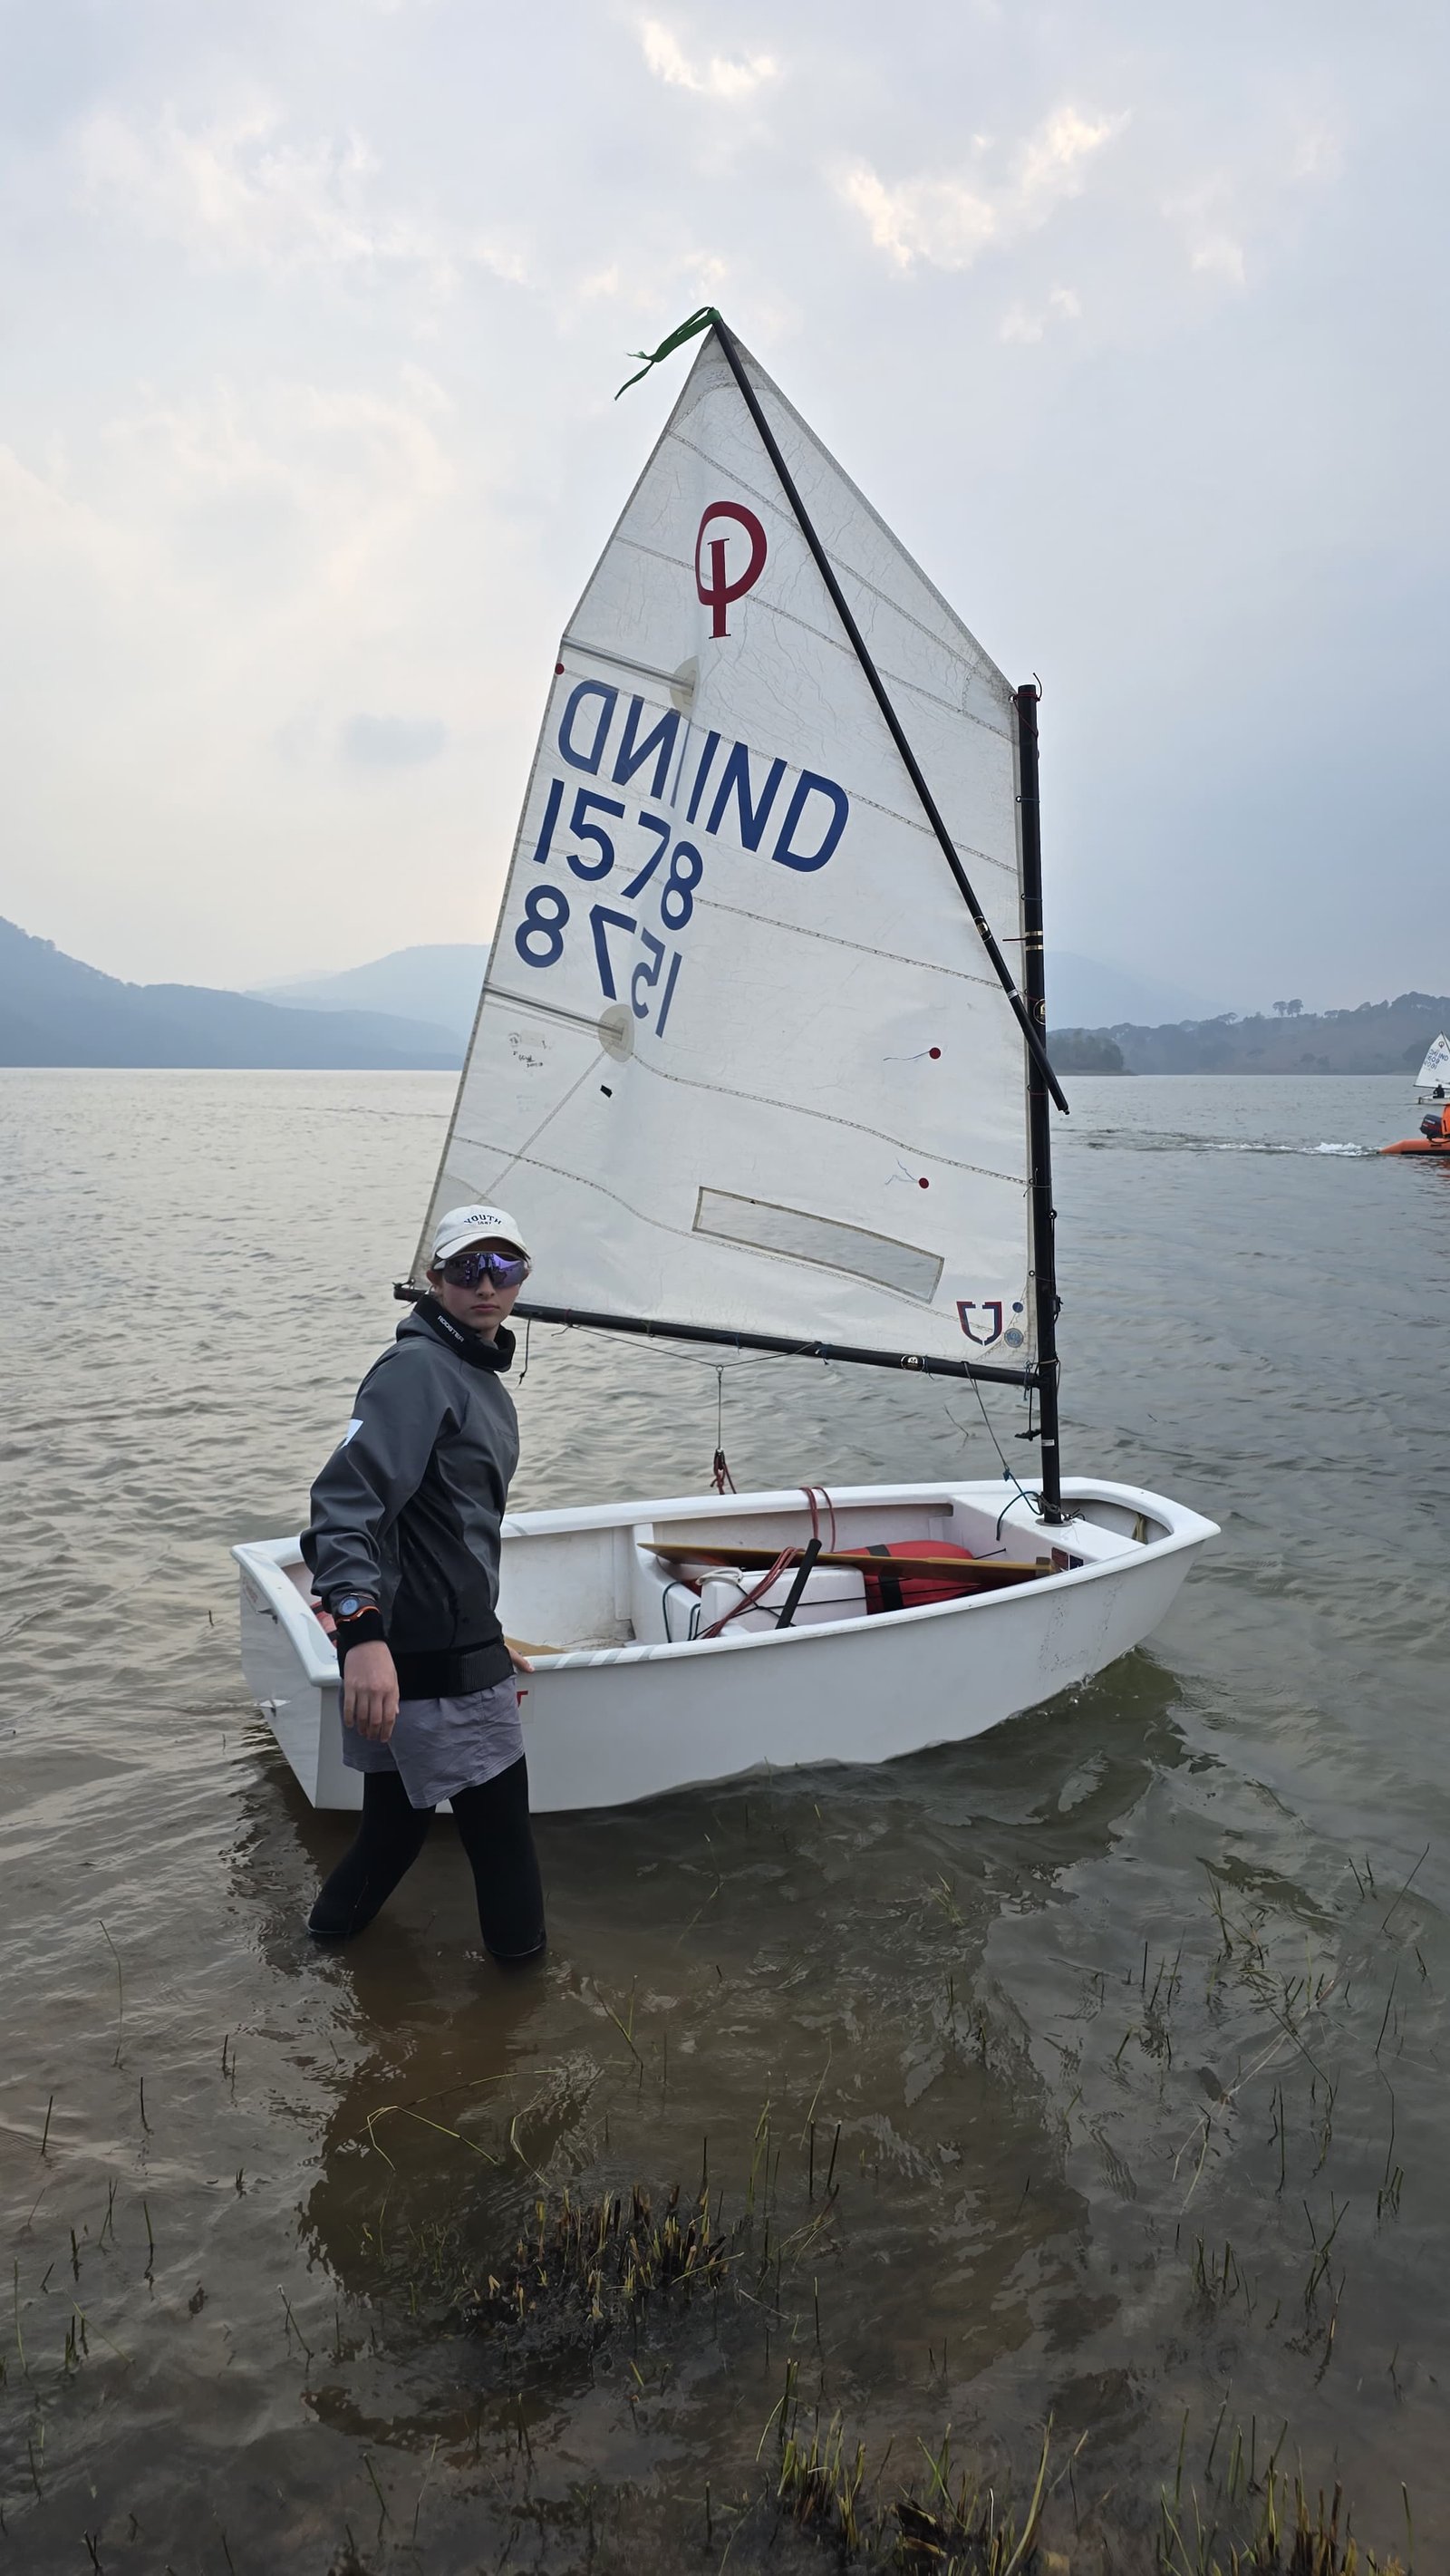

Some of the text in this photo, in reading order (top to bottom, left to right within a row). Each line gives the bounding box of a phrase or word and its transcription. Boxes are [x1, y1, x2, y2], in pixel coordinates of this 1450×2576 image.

[686, 730, 849, 873] IND
[533, 778, 703, 930] 1578
[463, 1214, 502, 1225] YOUTH
[437, 1315, 465, 1342] ROOSTER
